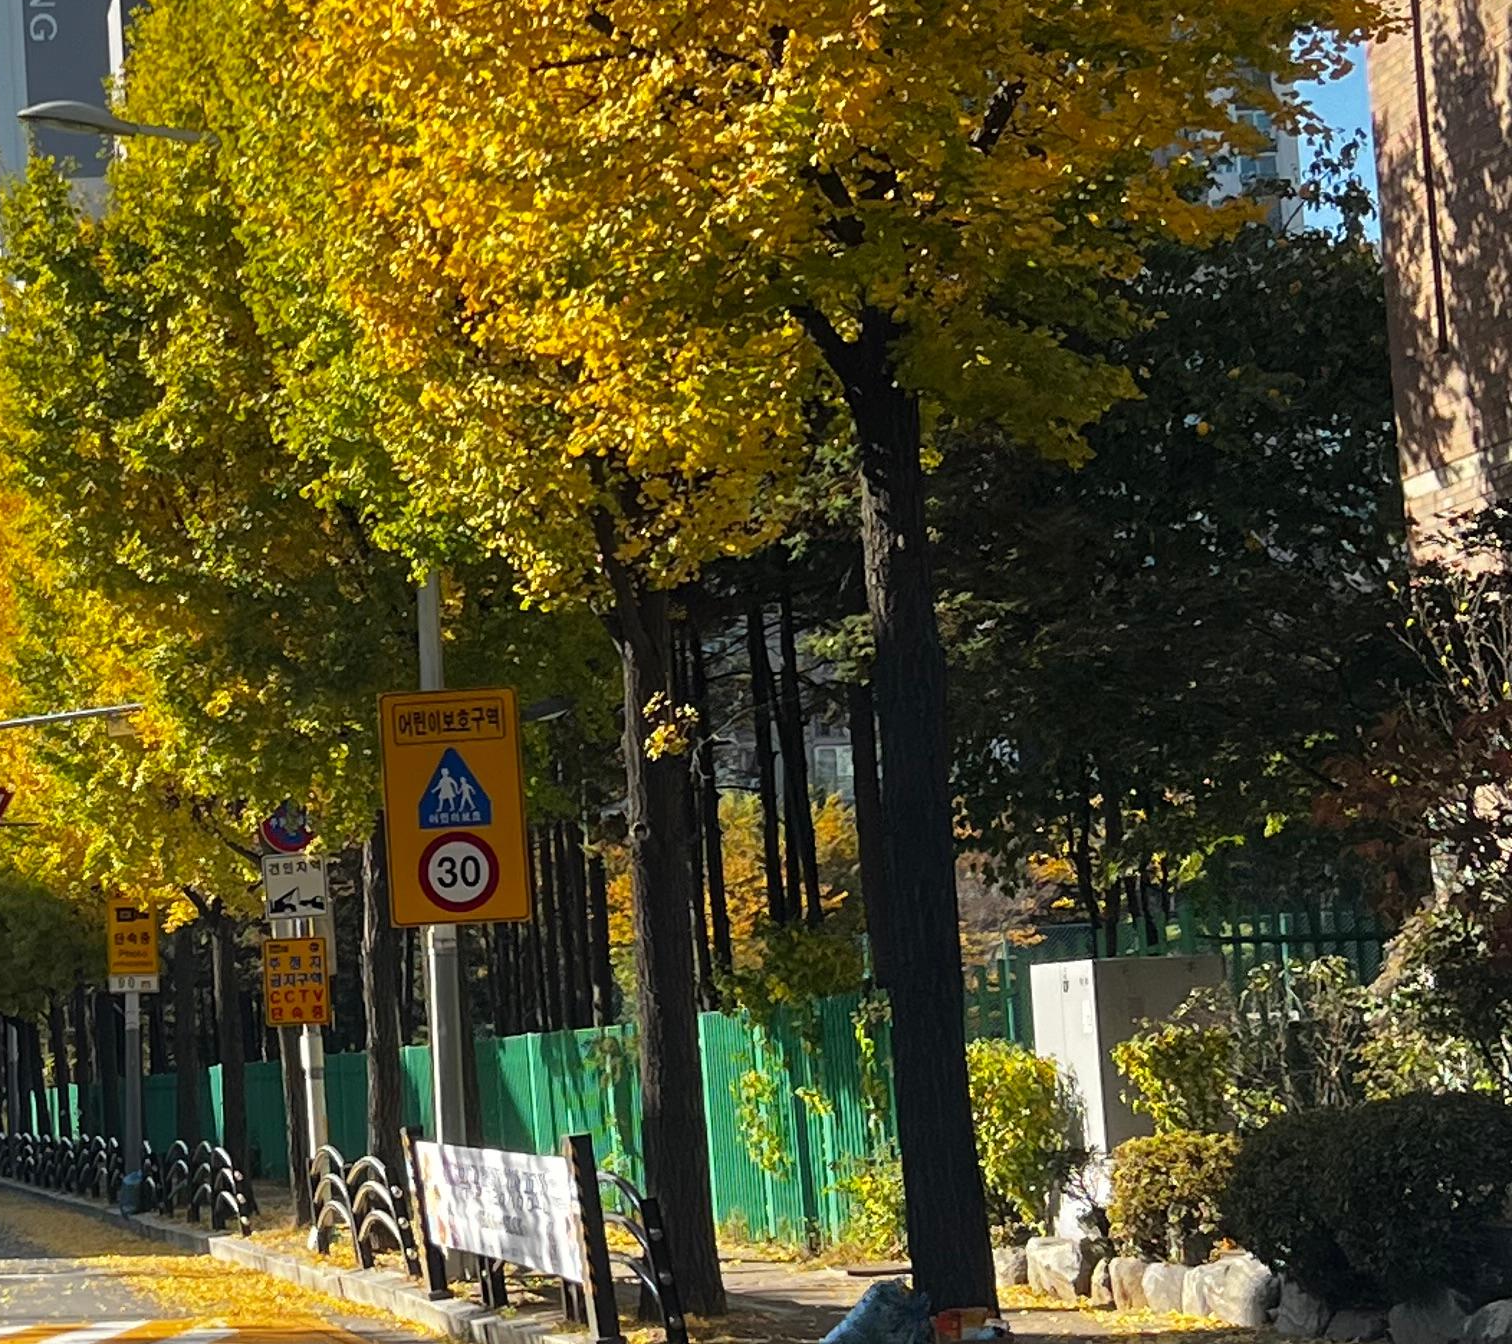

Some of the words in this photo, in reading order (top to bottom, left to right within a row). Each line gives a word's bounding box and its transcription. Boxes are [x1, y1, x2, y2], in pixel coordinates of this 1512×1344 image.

[398, 707, 501, 737] 어린이보호구역
[437, 855, 481, 889] 30
[270, 988, 324, 1004] CCTV
